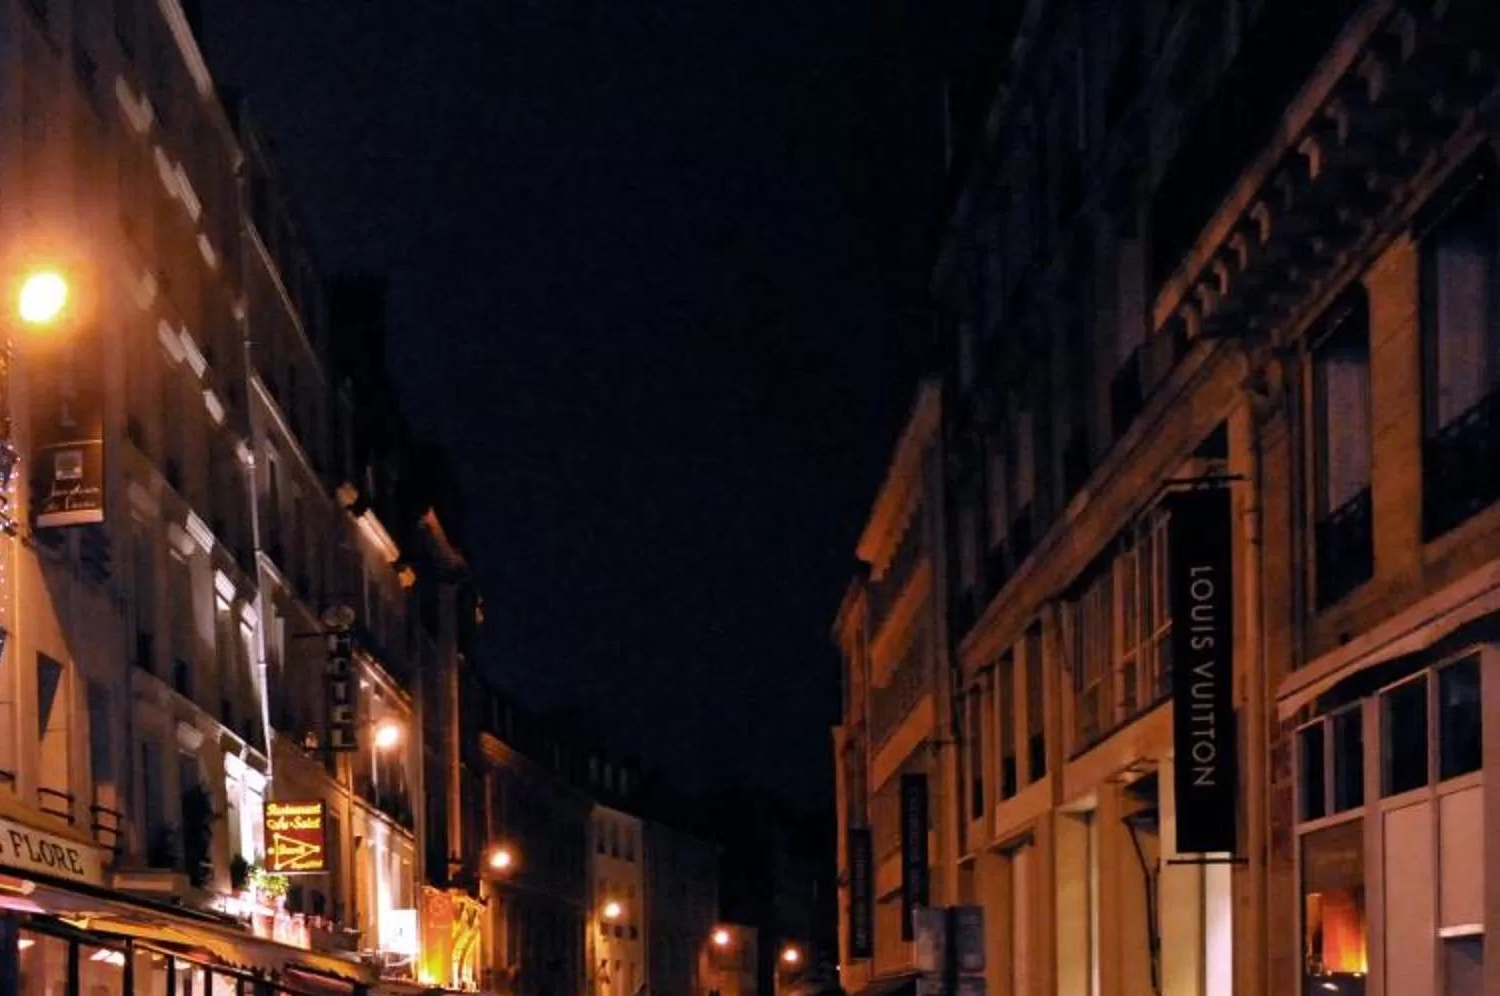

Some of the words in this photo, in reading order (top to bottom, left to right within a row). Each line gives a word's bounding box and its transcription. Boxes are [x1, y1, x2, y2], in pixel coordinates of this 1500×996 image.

[1190, 565, 1215, 650] LOUIS
[1191, 660, 1217, 787] VUITTON
[6, 830, 85, 875] FLORE
